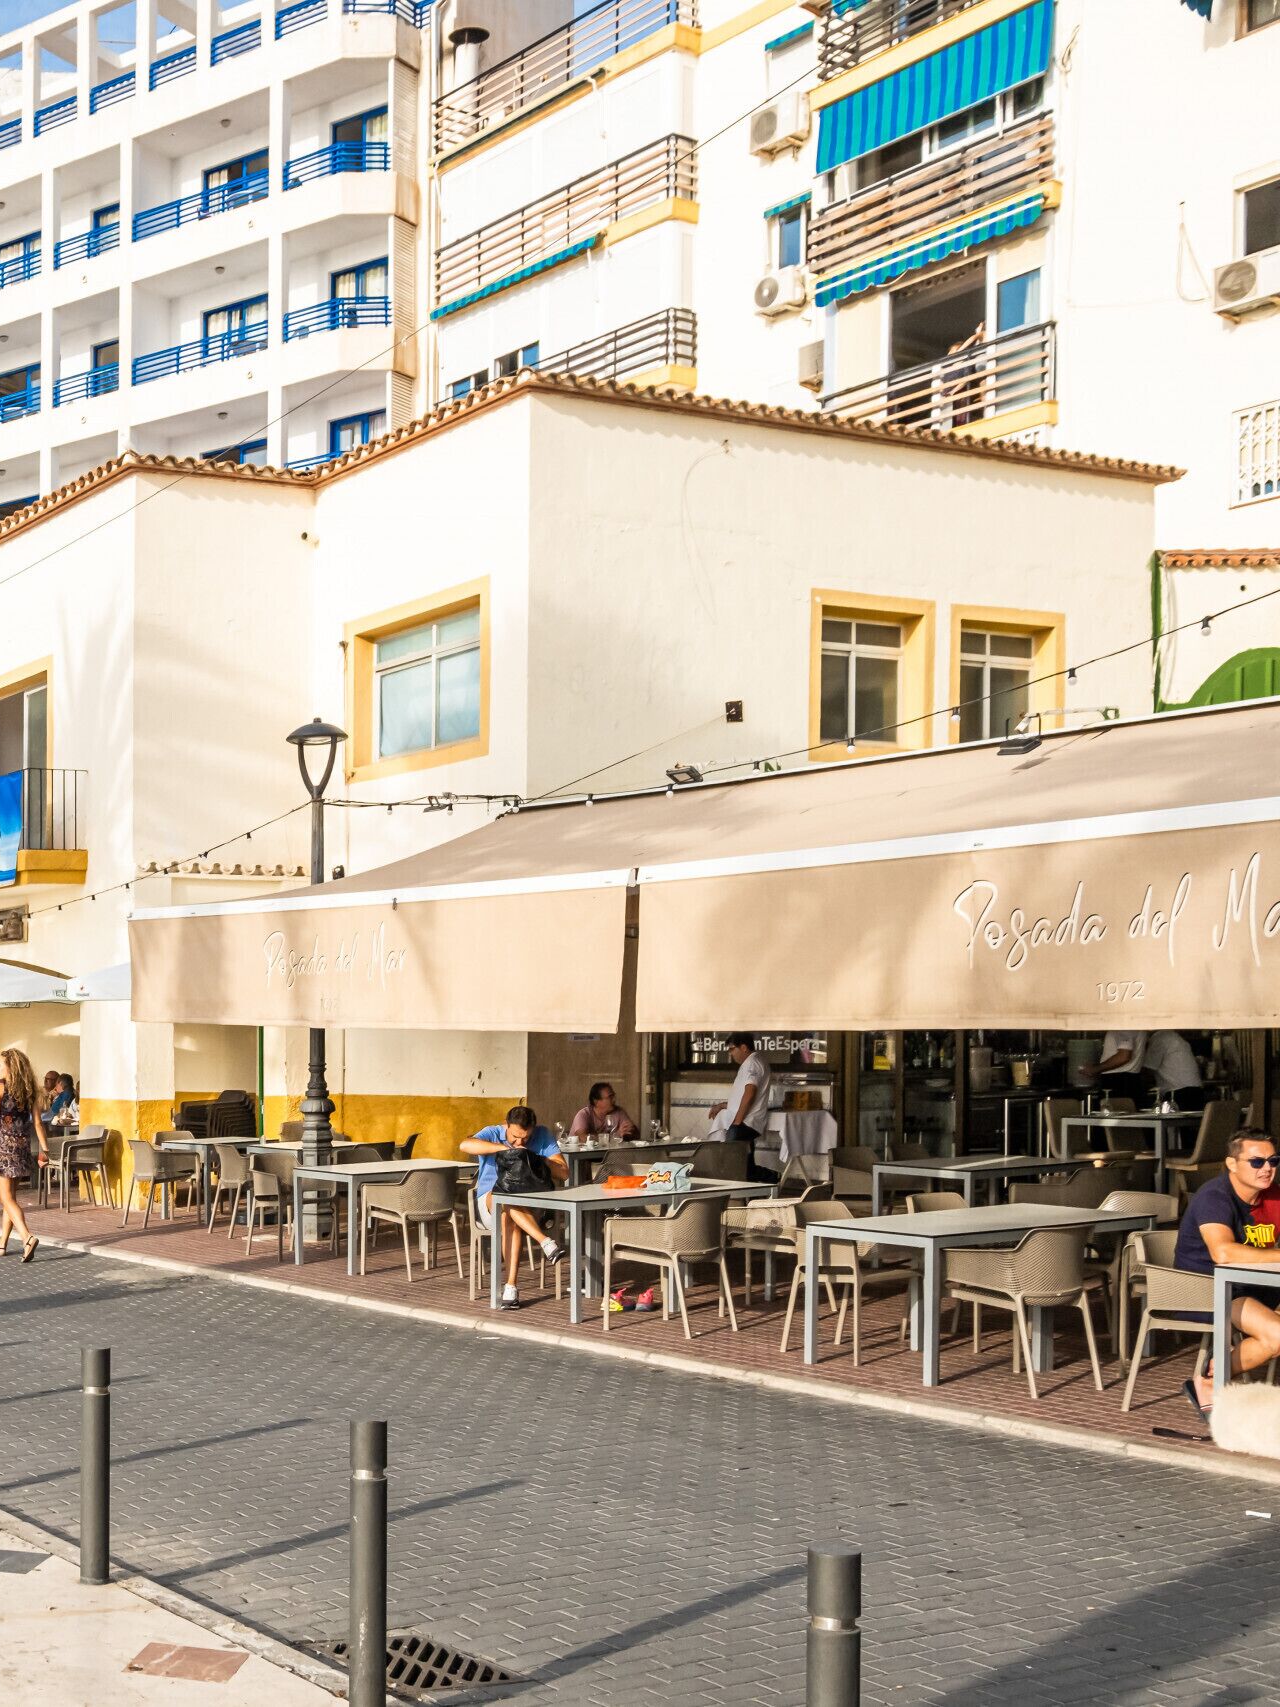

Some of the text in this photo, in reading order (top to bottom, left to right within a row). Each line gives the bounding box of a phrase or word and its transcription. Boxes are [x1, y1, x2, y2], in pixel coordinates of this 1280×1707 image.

[263, 920, 408, 991] Posada del Mar
[953, 880, 1109, 971] Posada
[1128, 872, 1192, 967] del
[1096, 980, 1146, 1003] 1972
